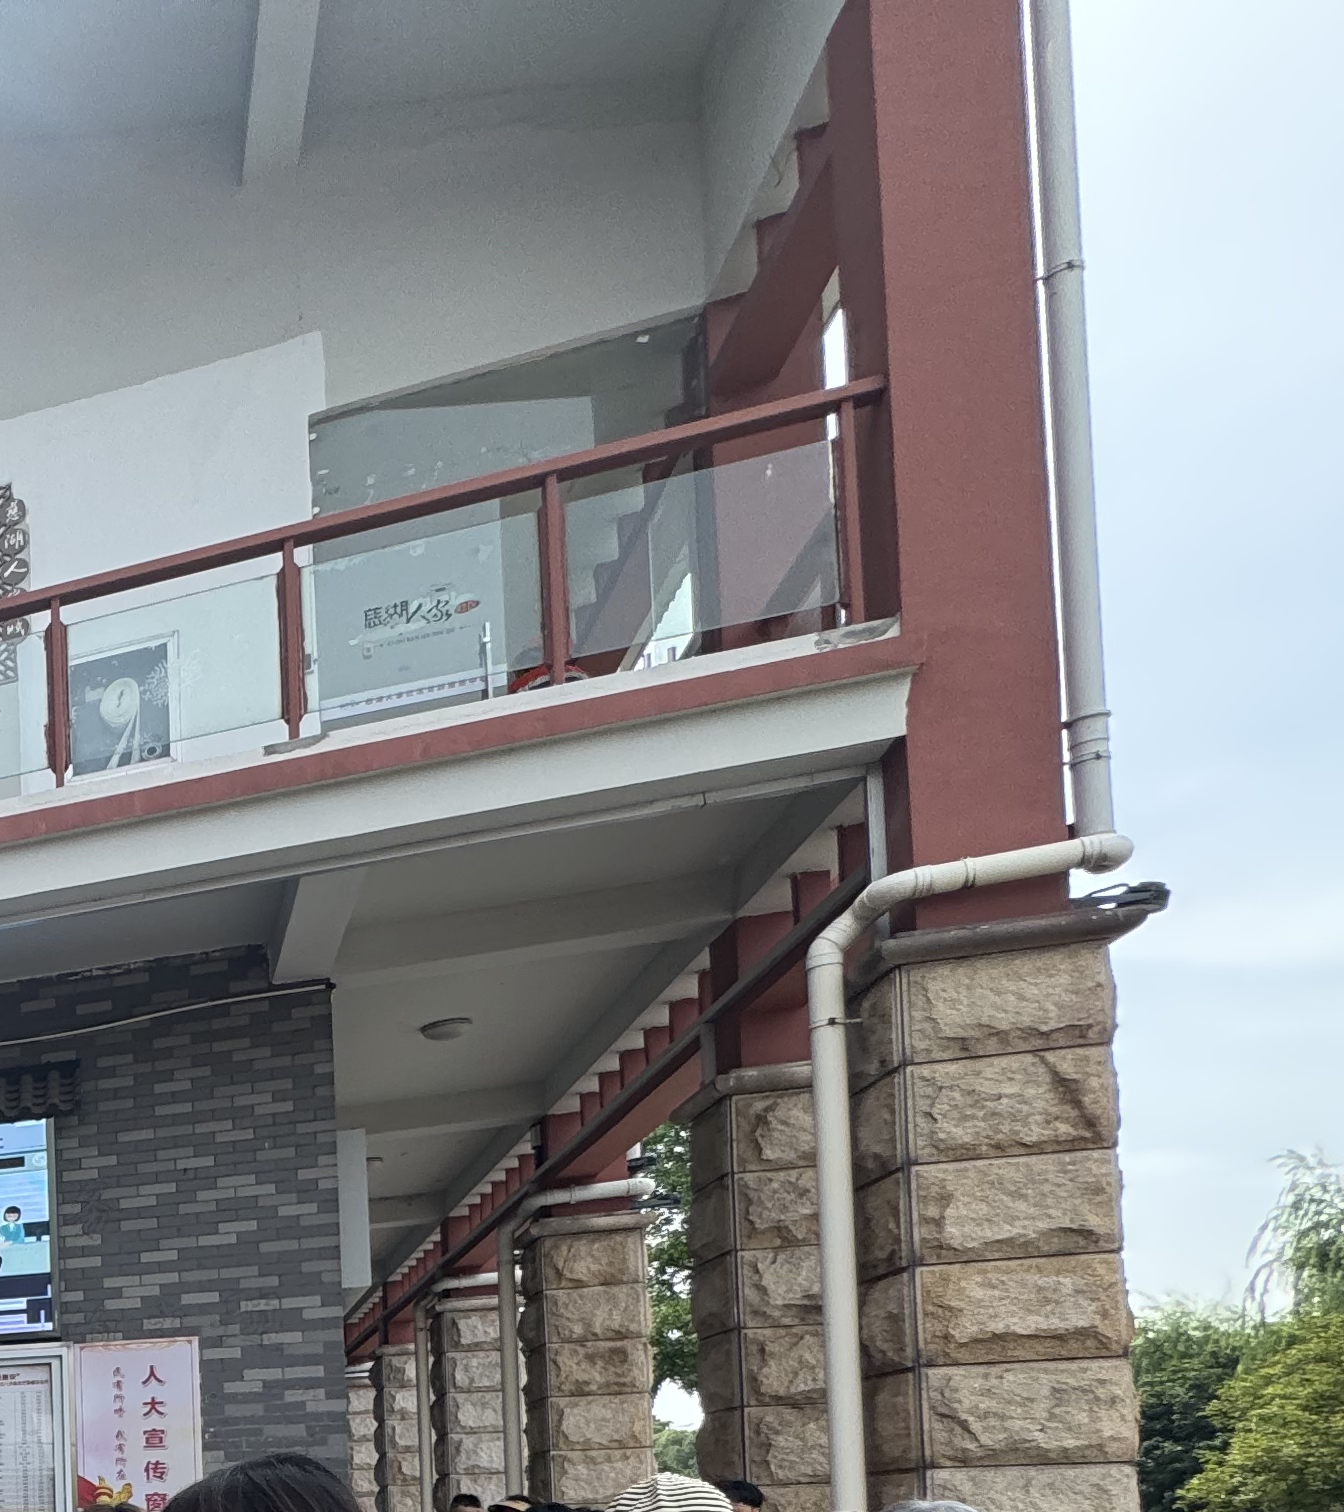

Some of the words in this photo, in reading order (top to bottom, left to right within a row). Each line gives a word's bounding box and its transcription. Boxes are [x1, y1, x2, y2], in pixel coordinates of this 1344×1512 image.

[141, 1365, 168, 1512] 人大宣传窗
